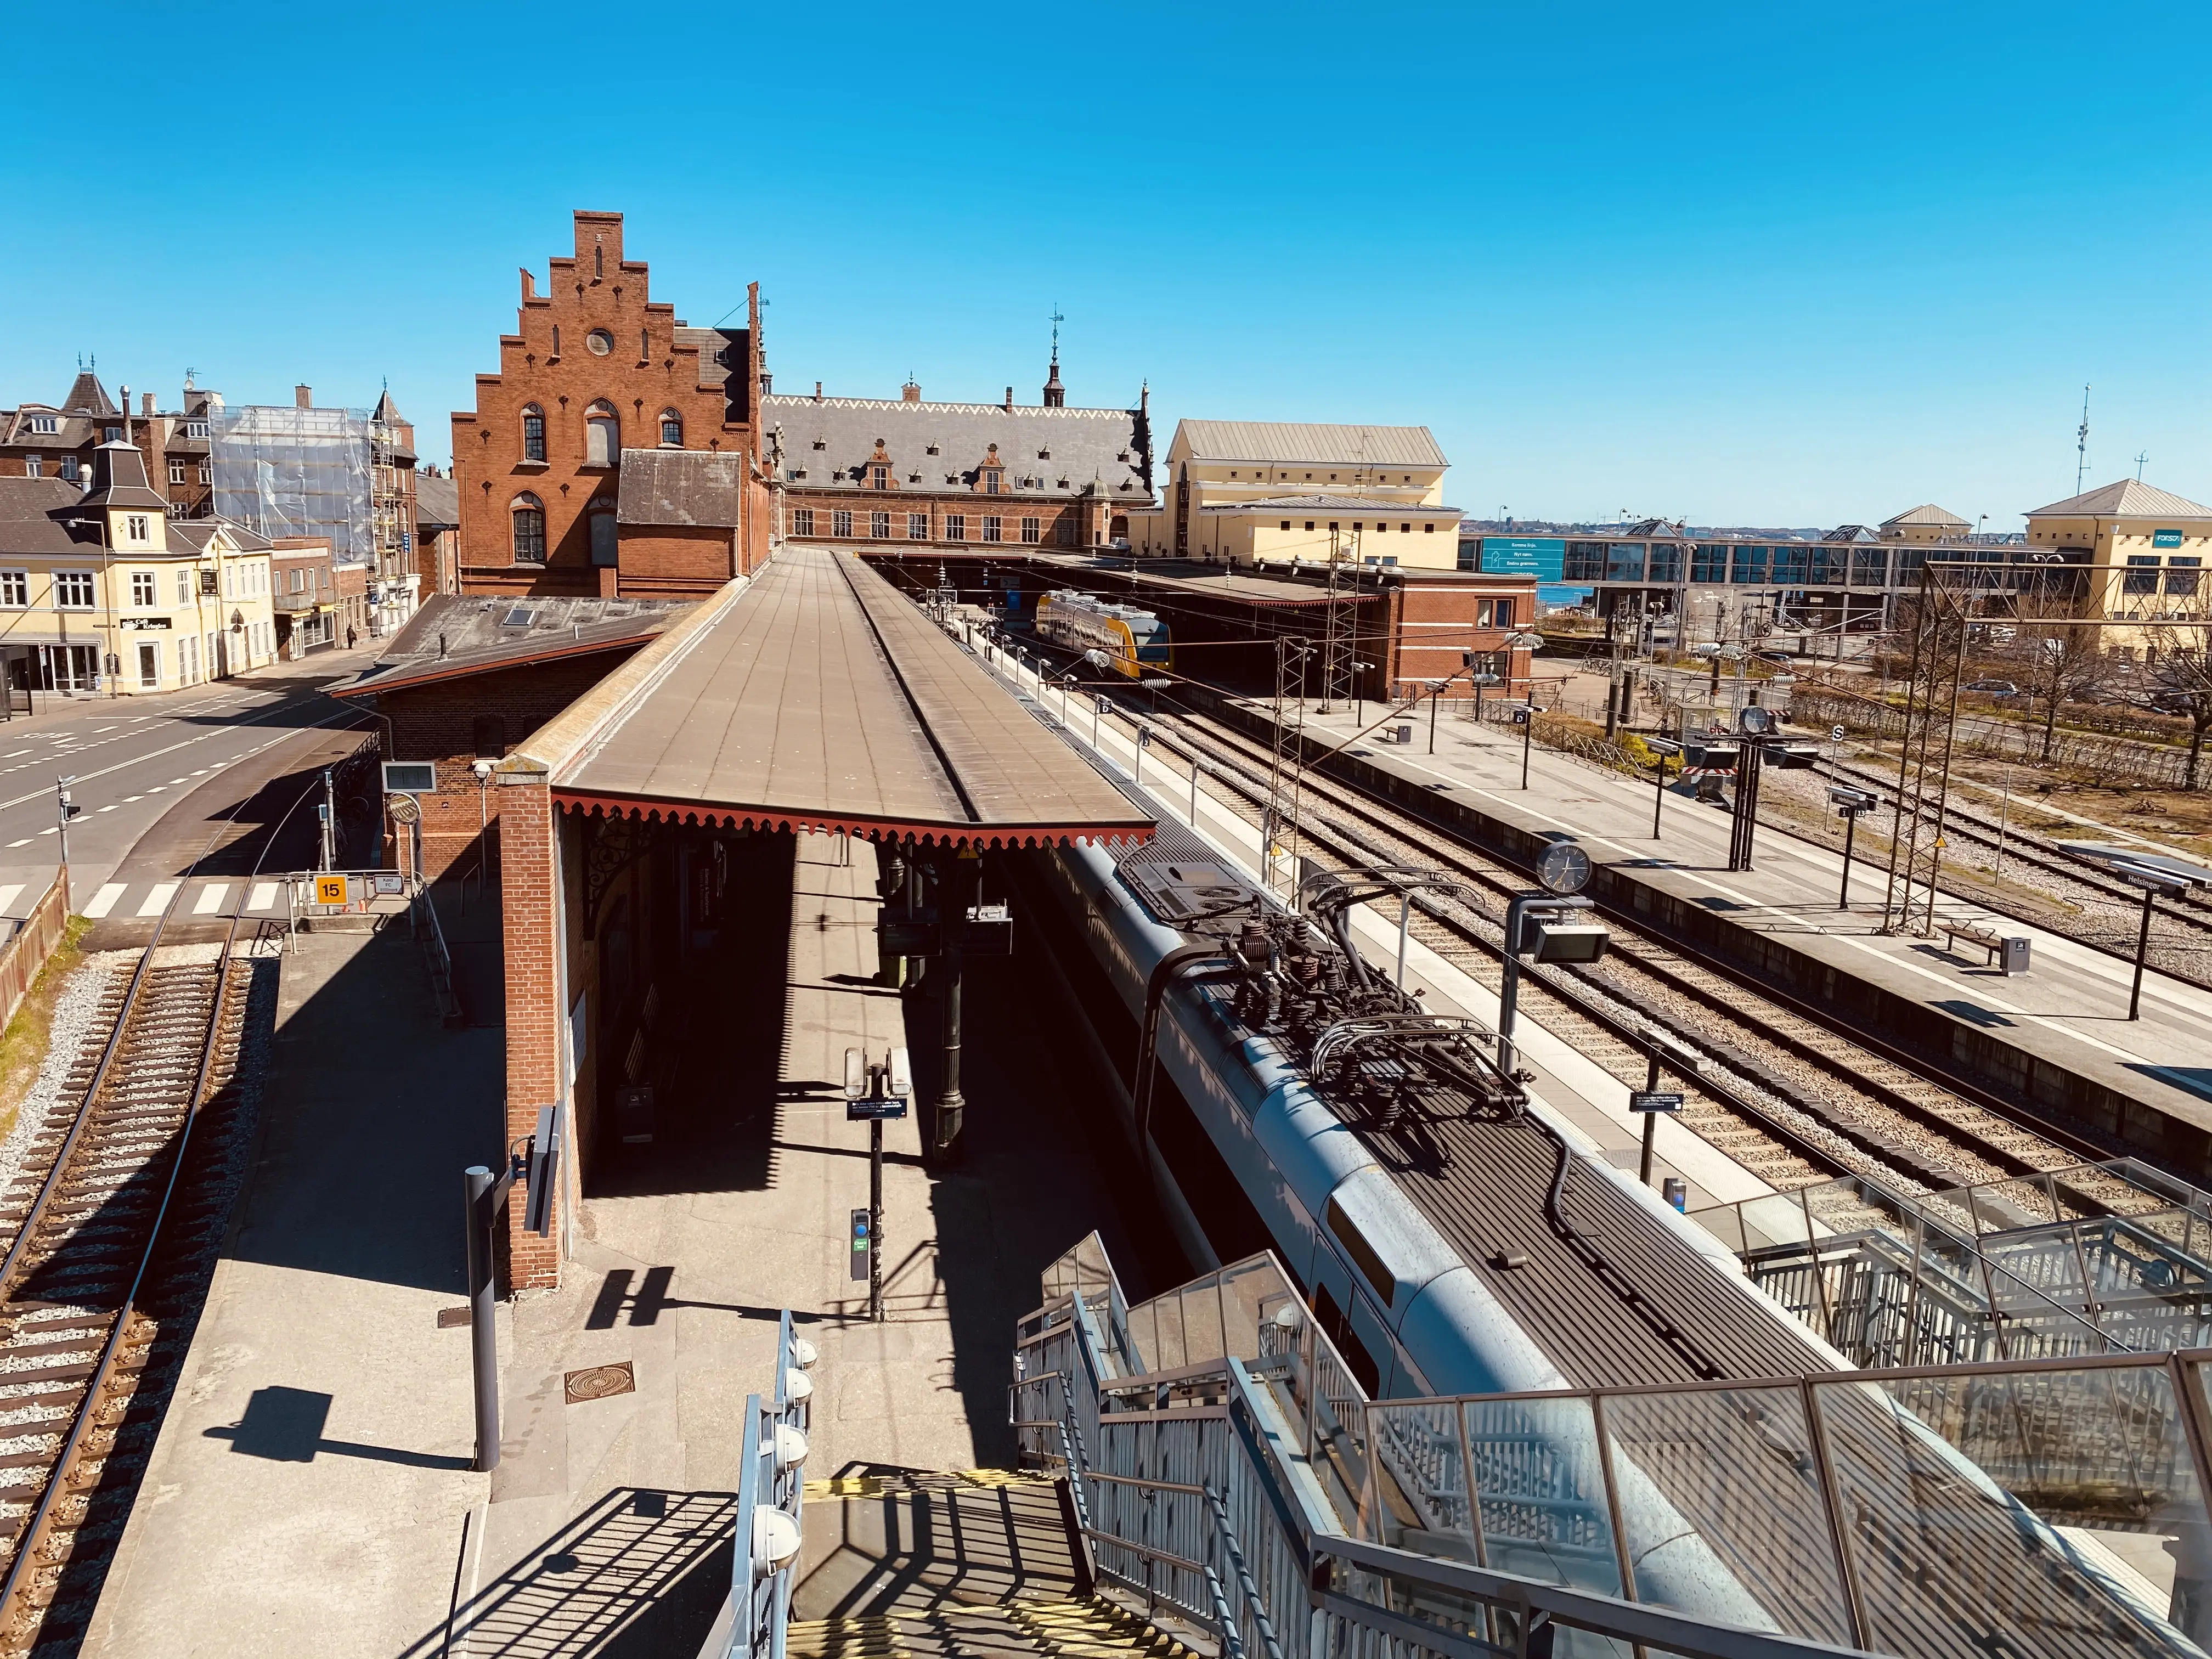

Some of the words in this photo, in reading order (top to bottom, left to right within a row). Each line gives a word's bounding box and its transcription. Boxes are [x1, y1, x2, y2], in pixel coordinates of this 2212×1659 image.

[1833, 727, 1843, 740] S
[2128, 874, 2161, 890] Helsingør
[322, 884, 340, 897] 15
